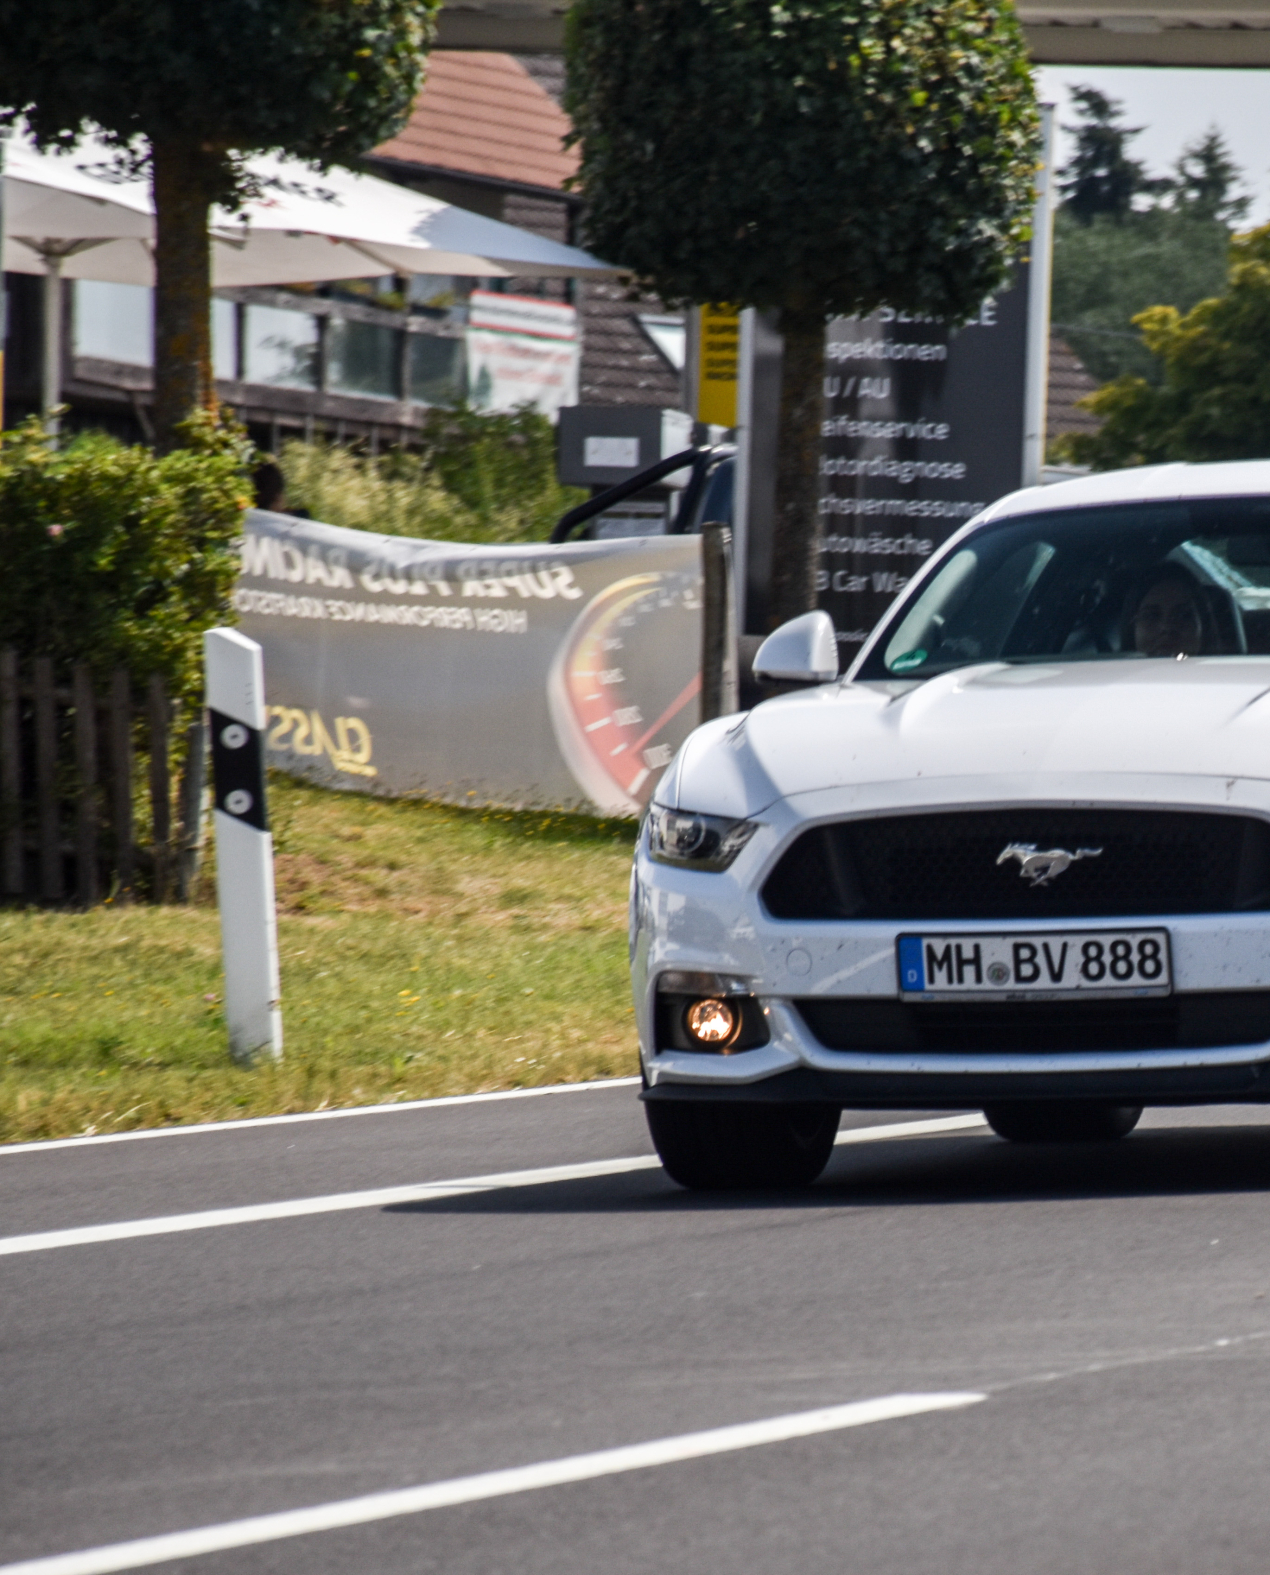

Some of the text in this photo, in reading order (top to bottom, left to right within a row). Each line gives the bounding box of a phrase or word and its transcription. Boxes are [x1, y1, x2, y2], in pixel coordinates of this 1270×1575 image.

[857, 377, 891, 399] AU
[832, 569, 869, 593] Car
[925, 938, 1164, 986] MH BV 888
